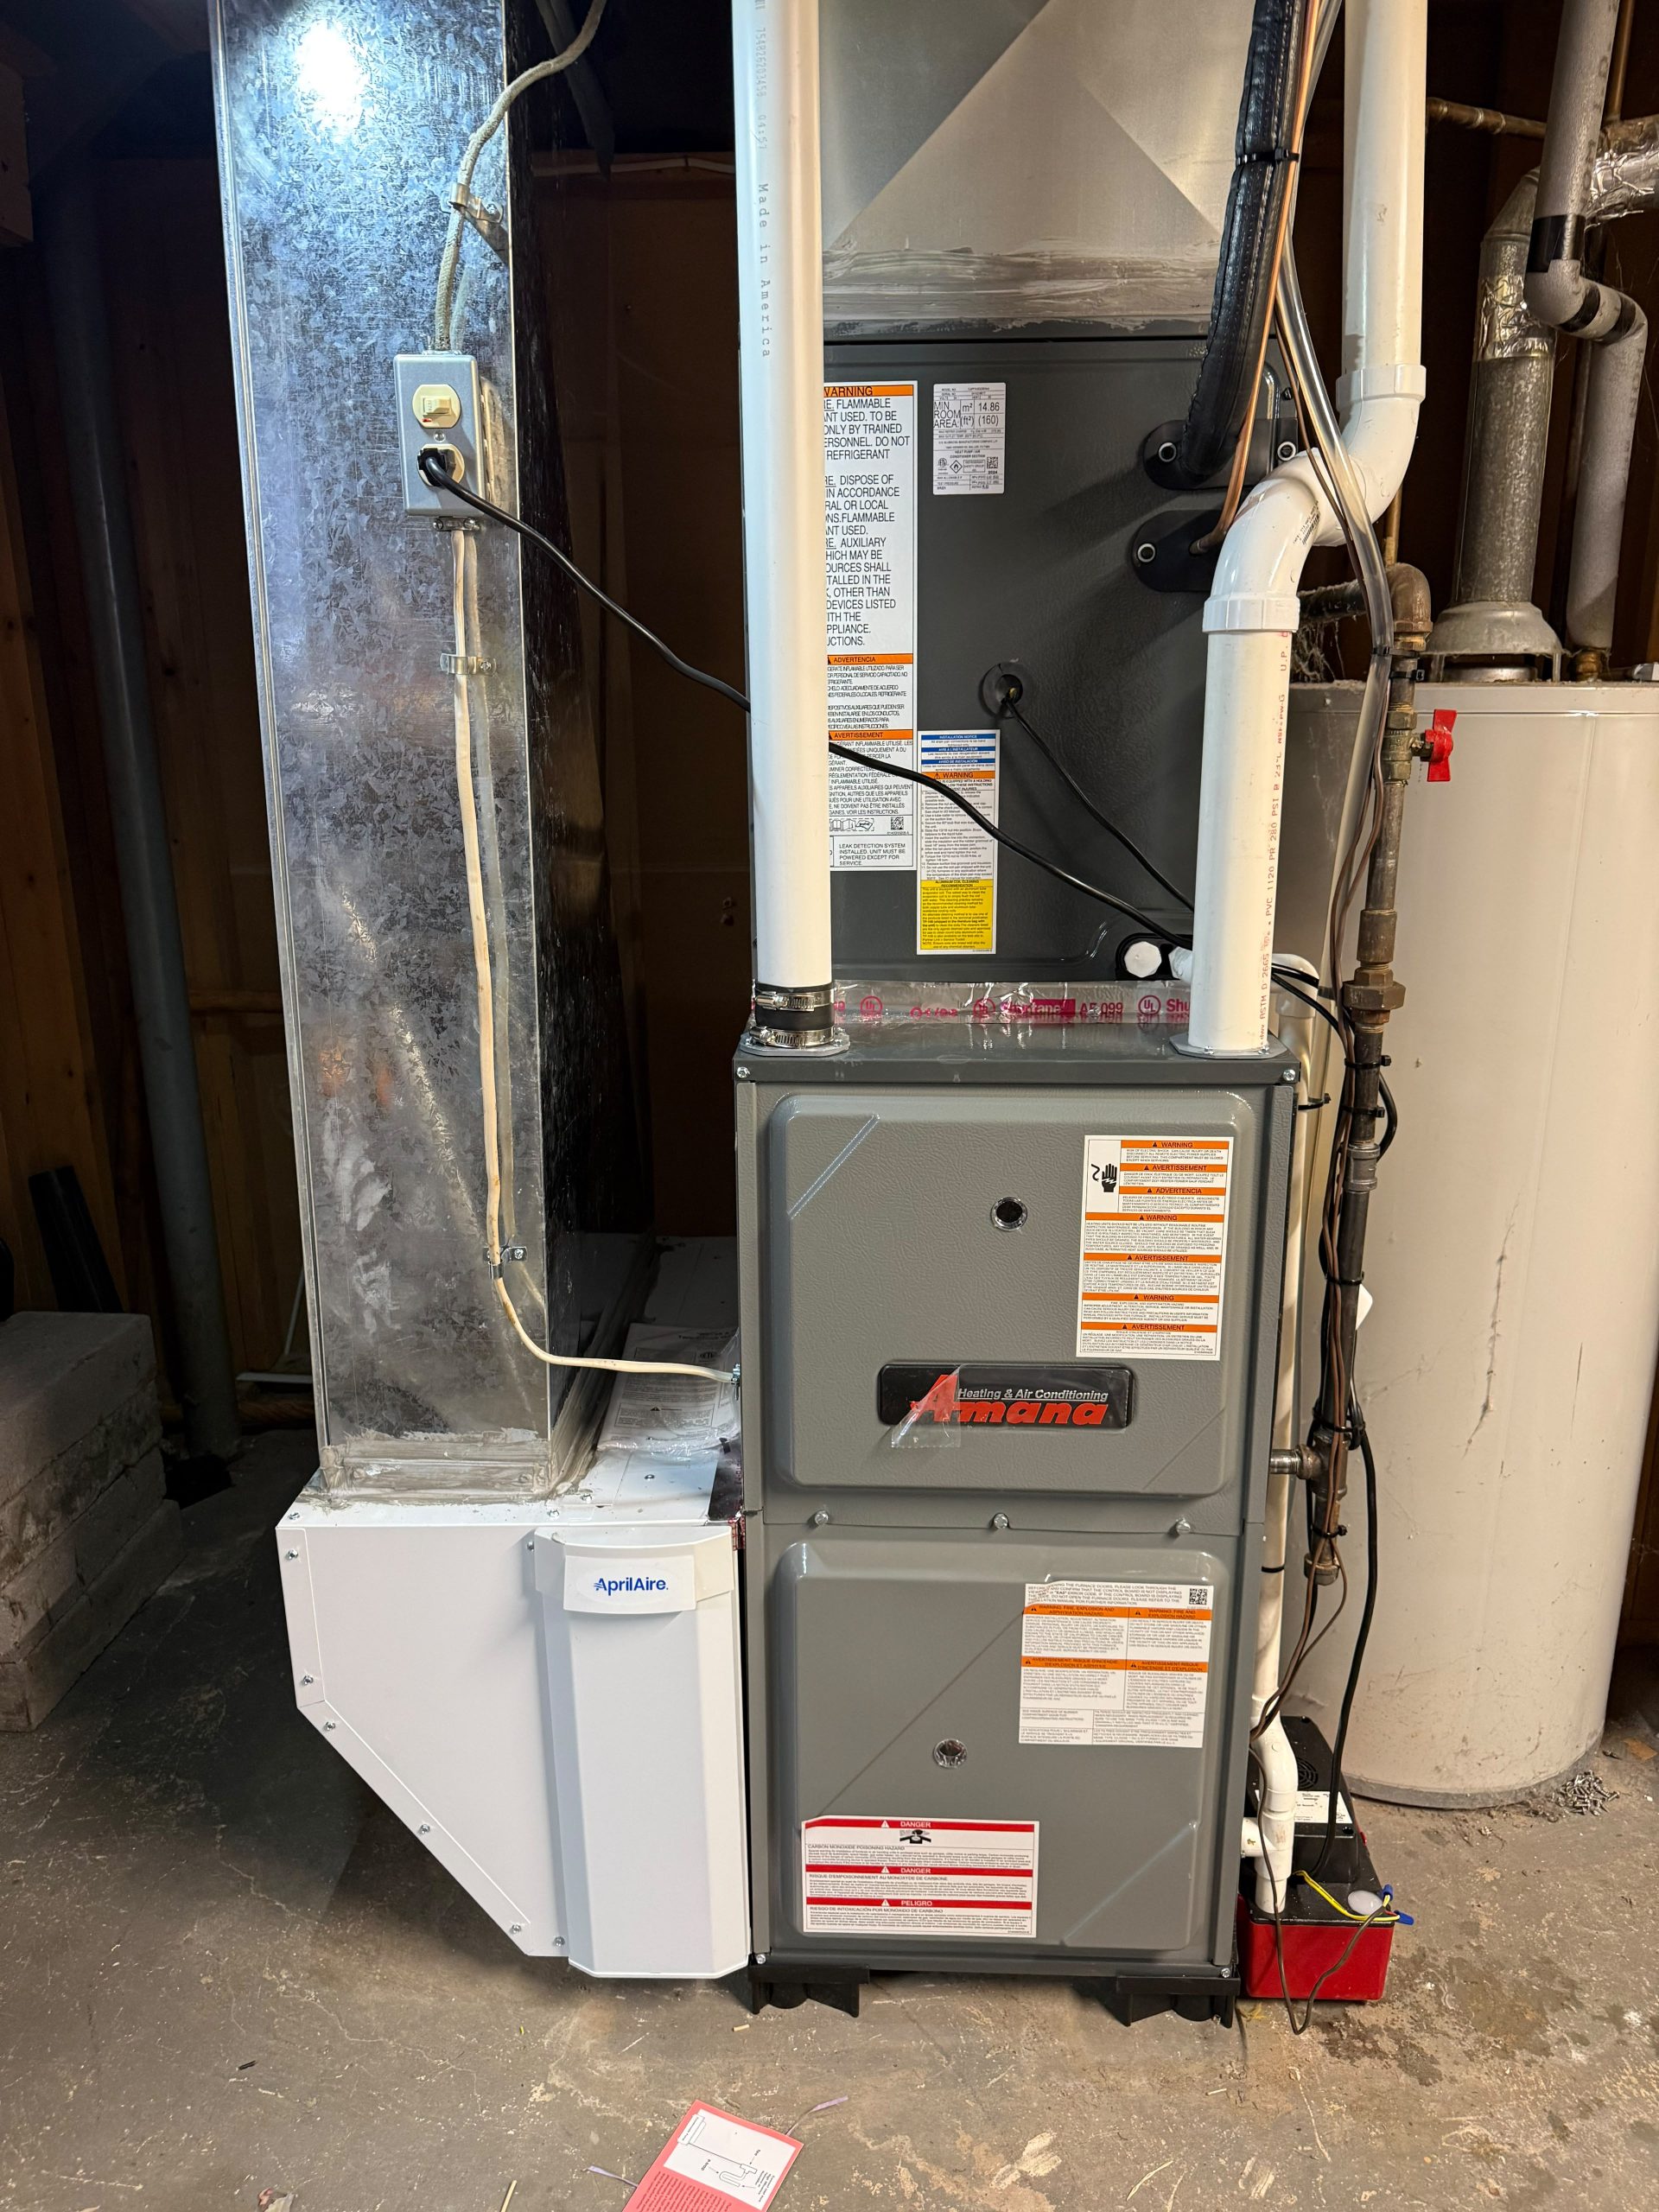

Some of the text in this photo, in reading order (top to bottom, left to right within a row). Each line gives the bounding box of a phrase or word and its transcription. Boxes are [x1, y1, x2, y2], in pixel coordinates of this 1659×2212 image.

[758, 182, 772, 358] Made in America
[836, 398, 891, 410] FLAMMABLE
[935, 401, 949, 410] MIN
[978, 403, 1000, 411] 14.86
[840, 411, 868, 422] USED.
[869, 411, 882, 422] TO
[885, 410, 897, 421] BE
[933, 410, 961, 418] ROOM
[978, 415, 999, 427] (160)
[849, 424, 861, 435] BY
[862, 423, 902, 434] TRAINED
[824, 435, 911, 448] ERSONNEL. DO NOT
[826, 449, 890, 460] REFRIGERANT
[840, 474, 880, 486] DISPOSE
[881, 474, 893, 484] OF
[826, 487, 900, 498] IN ACCORDANCE
[843, 500, 857, 510] OR
[859, 499, 888, 510] LOCAL
[842, 525, 868, 536] USED.
[840, 537, 887, 548] AUXILIARY
[826, 550, 883, 560] HICH MAY BE
[826, 562, 892, 573] OURCES SHALL
[862, 575, 871, 584] IN
[873, 574, 891, 584] THE
[833, 588, 864, 598] OTHER
[866, 587, 890, 596] THAN
[826, 600, 896, 610] DEVICES LISTED
[828, 612, 861, 622] ITH THE
[826, 624, 871, 634] PPLIANCE.
[1268, 847, 1275, 861] PR
[1267, 866, 1275, 890] 1120
[1101, 1002, 1123, 1014] 099
[910, 1374, 1109, 1426] Amana
[957, 1388, 1109, 1402] Heating & Air Conditioning
